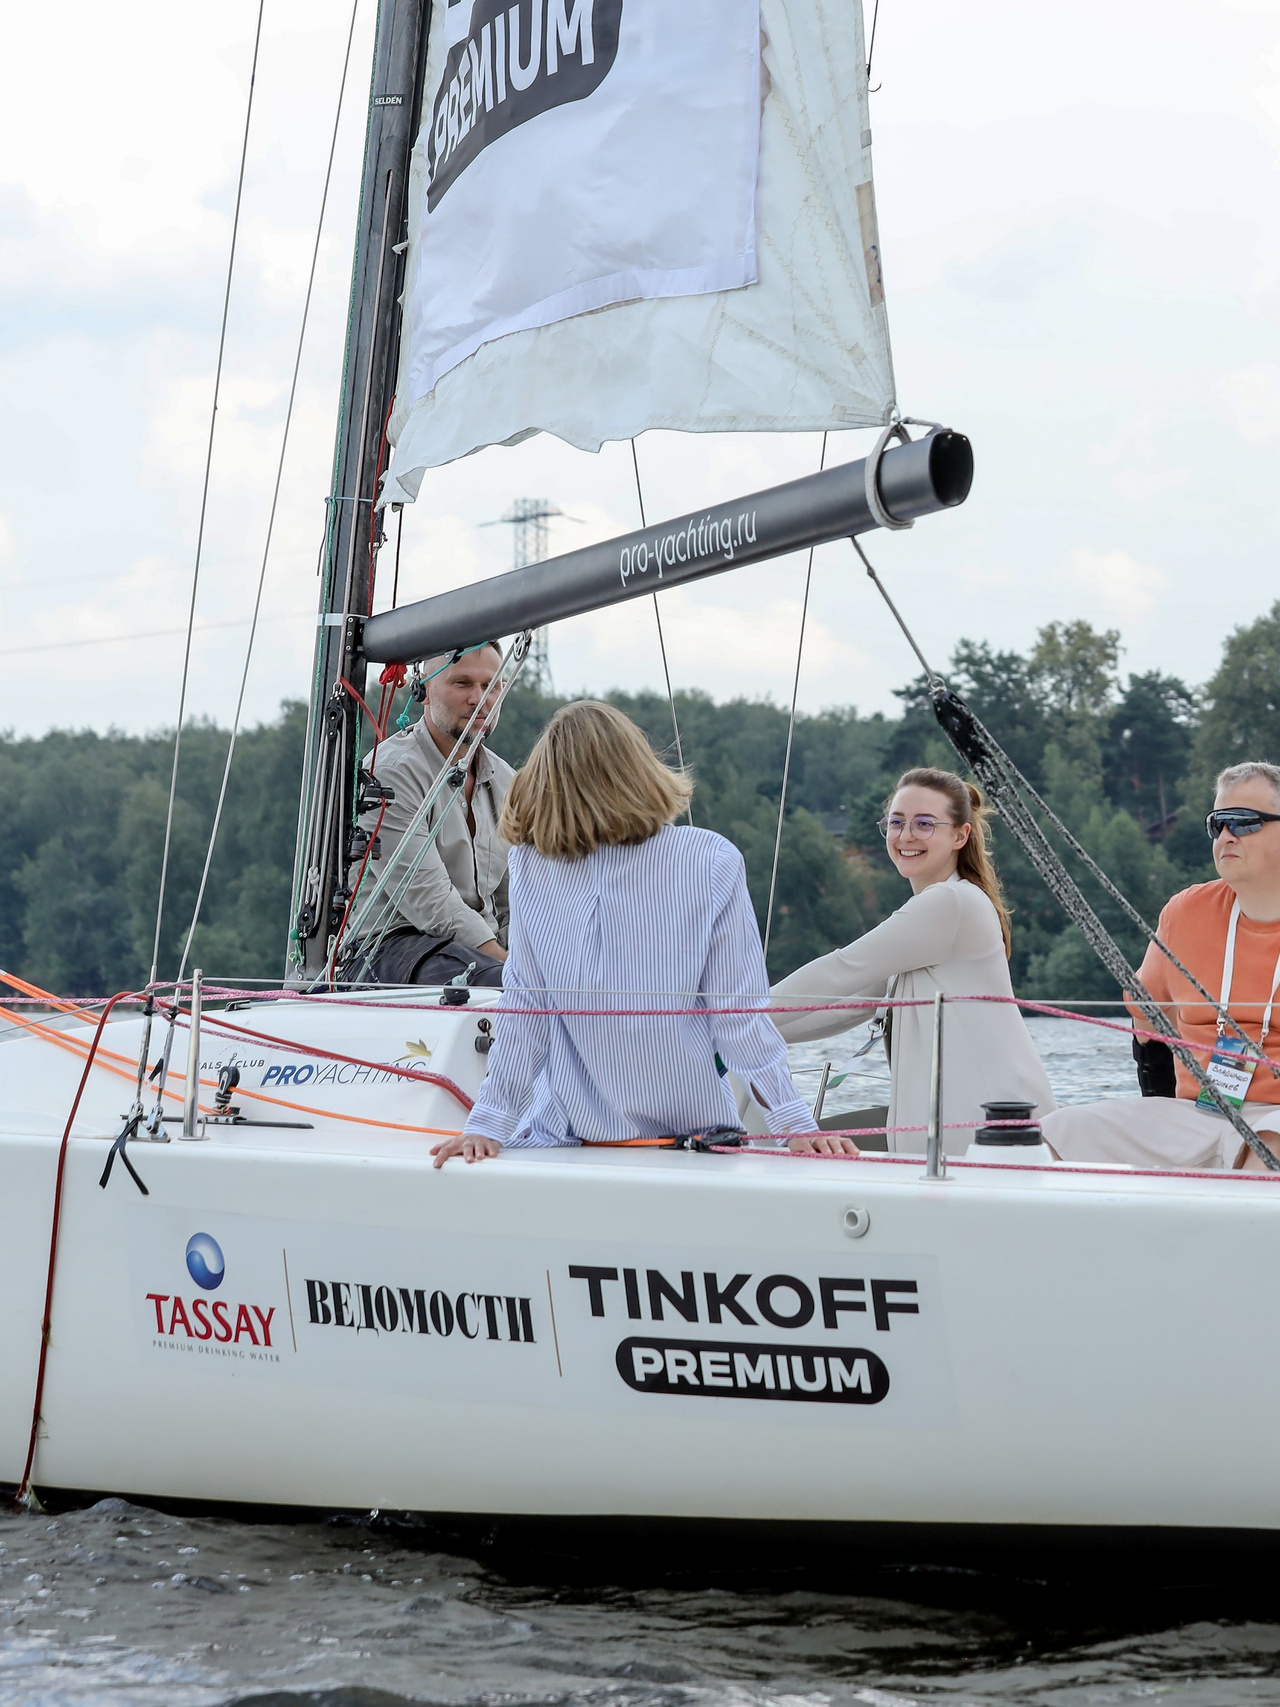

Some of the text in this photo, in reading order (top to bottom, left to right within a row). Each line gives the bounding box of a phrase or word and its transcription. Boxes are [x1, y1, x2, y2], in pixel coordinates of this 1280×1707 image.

[374, 95, 402, 105] SELDÉN
[431, 0, 594, 182] PREMIUM
[620, 511, 757, 587] pro-yachting.ru
[235, 1059, 265, 1068] CLUB
[260, 1061, 426, 1088] PROYACHTING
[145, 1293, 276, 1347] TASSAY
[304, 1279, 537, 1343] ВЕДОМОСТИ
[568, 1265, 919, 1331] TINKOFF
[152, 1340, 281, 1363] PREMIUM DRINKING WATER
[631, 1347, 872, 1394] PREMIUM
